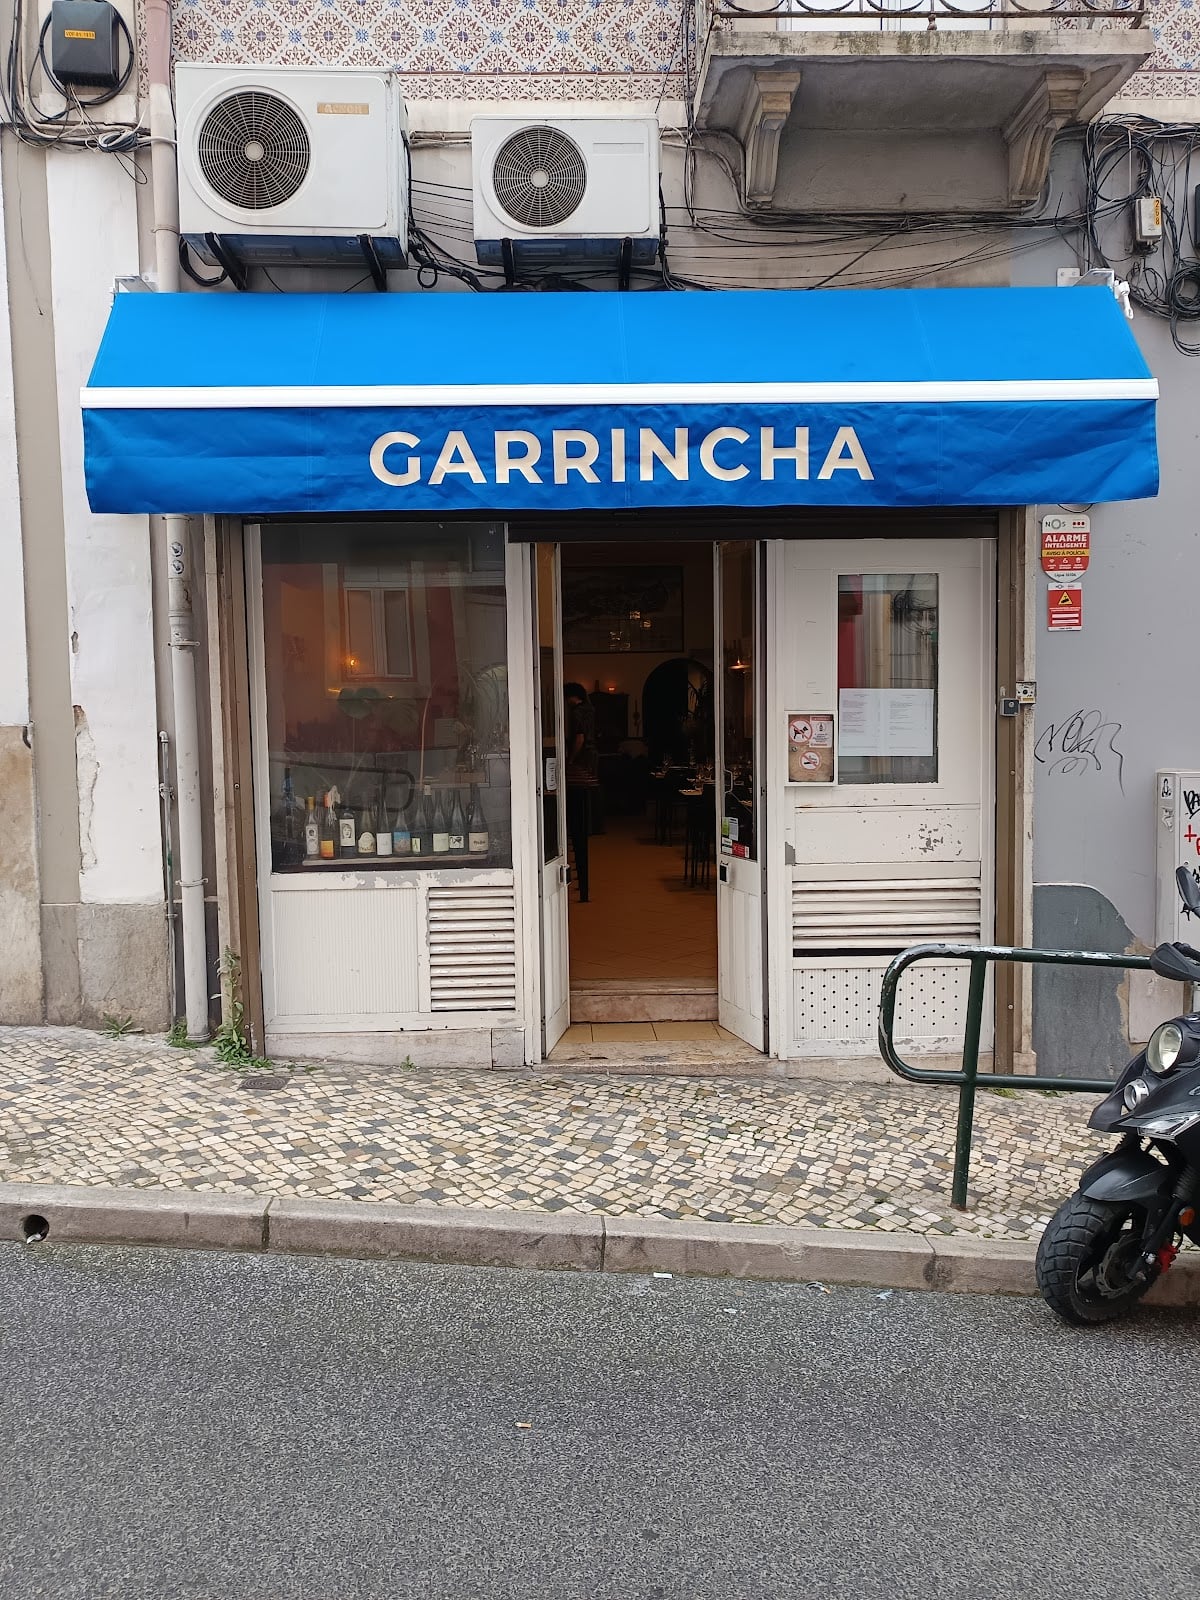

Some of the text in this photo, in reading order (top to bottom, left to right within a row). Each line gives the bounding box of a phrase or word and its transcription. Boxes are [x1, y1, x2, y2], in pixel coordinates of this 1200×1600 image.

[370, 427, 874, 486] GARRINCHA
[1045, 519, 1066, 529] NOS
[1045, 534, 1087, 542] ALARME
